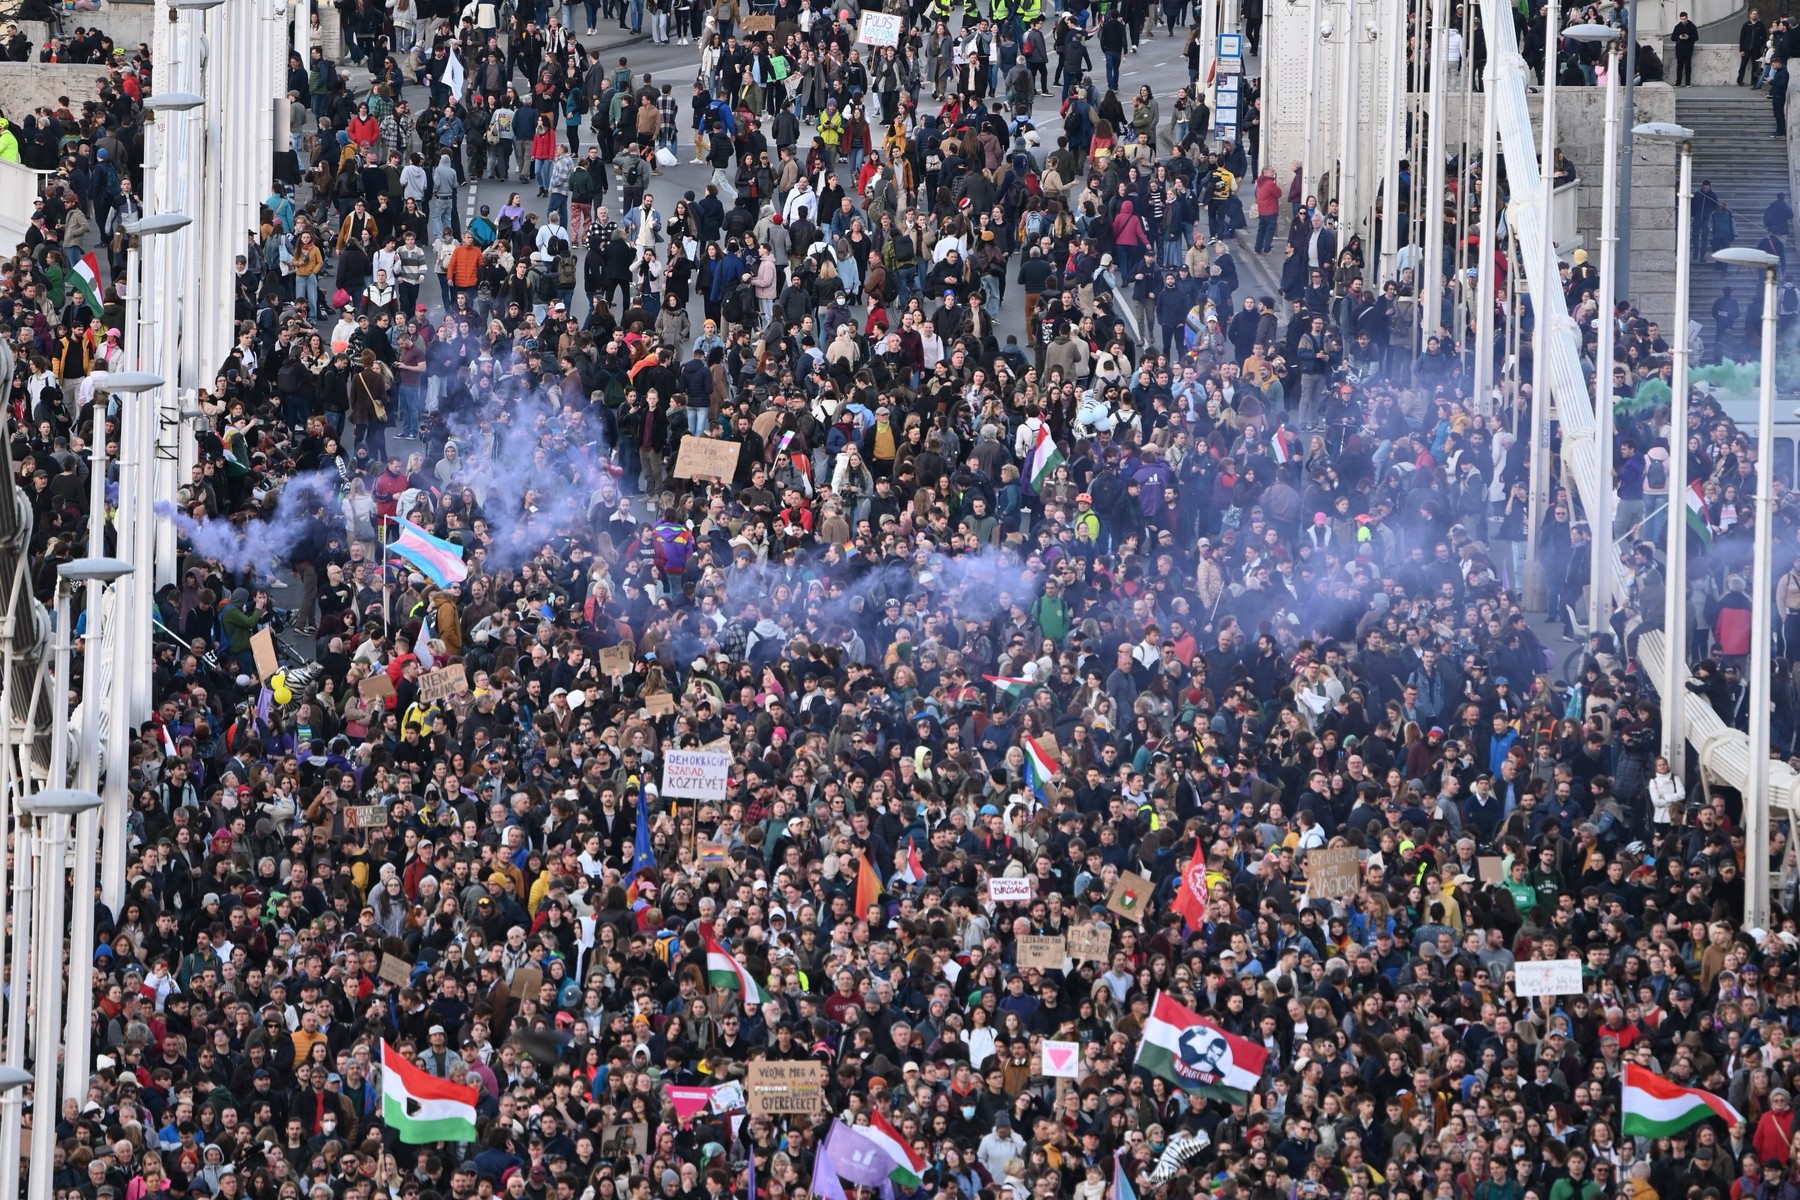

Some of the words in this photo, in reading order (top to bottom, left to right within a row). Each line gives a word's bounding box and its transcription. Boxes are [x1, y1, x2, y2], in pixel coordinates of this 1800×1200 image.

[864, 26, 896, 40] VAGYOK
[422, 671, 450, 689] NEM
[669, 754, 729, 767] DEMOKRÁCIÁT
[668, 765, 704, 777] SZABAD
[1069, 942, 1108, 956] POLOSKA
[789, 1068, 806, 1077] MEG
[810, 1067, 816, 1077] A
[761, 1096, 817, 1110] GYEREKEKET
